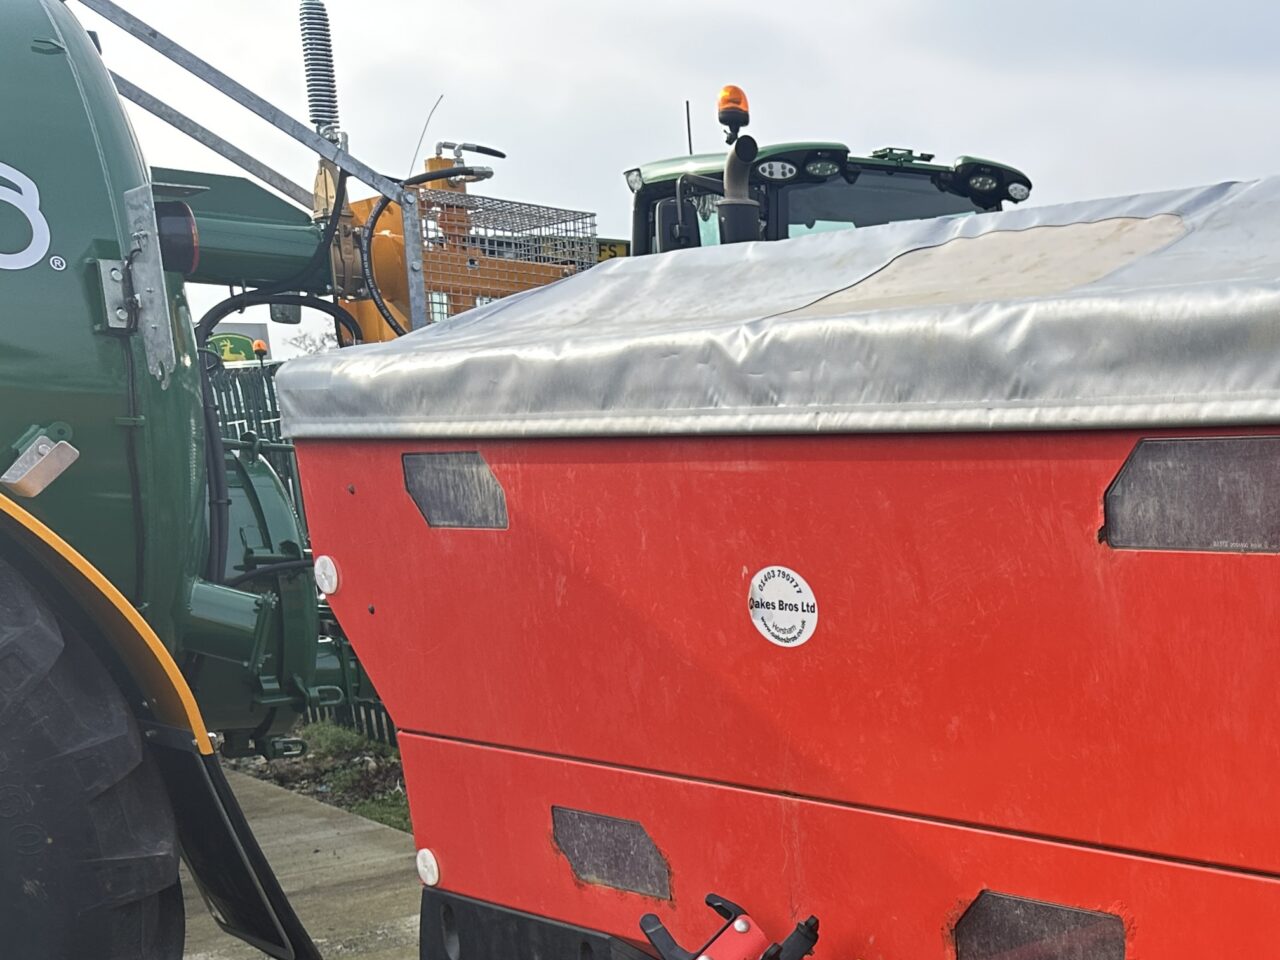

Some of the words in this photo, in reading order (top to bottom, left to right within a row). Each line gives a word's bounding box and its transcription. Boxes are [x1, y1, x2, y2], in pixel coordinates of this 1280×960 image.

[758, 569, 776, 592] 01403
[777, 569, 802, 593] 790777
[778, 599, 799, 612] Bros
[801, 602, 815, 613] Ltd
